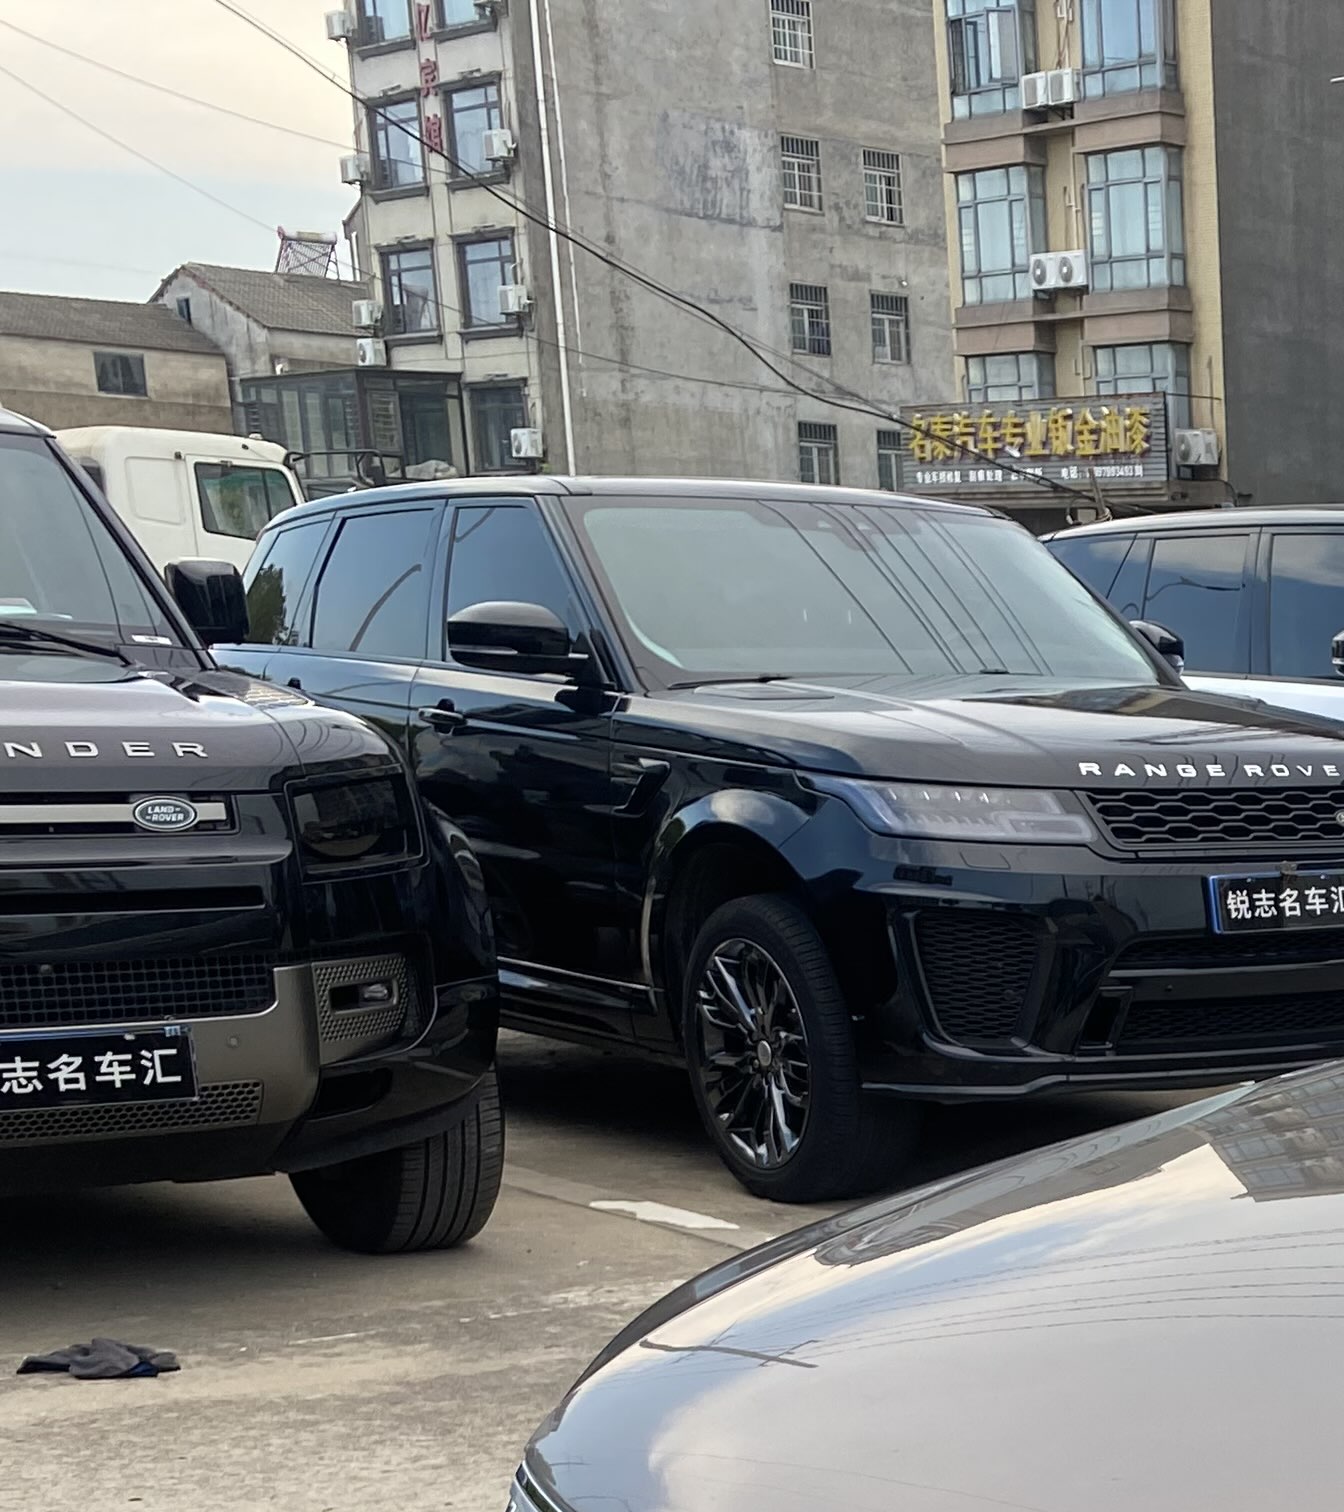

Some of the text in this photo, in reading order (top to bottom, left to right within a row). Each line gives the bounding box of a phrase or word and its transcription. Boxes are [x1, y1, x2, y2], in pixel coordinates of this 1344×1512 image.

[1078, 761, 1226, 778] RANGE
[0, 1048, 182, 1094] 志名车汇
